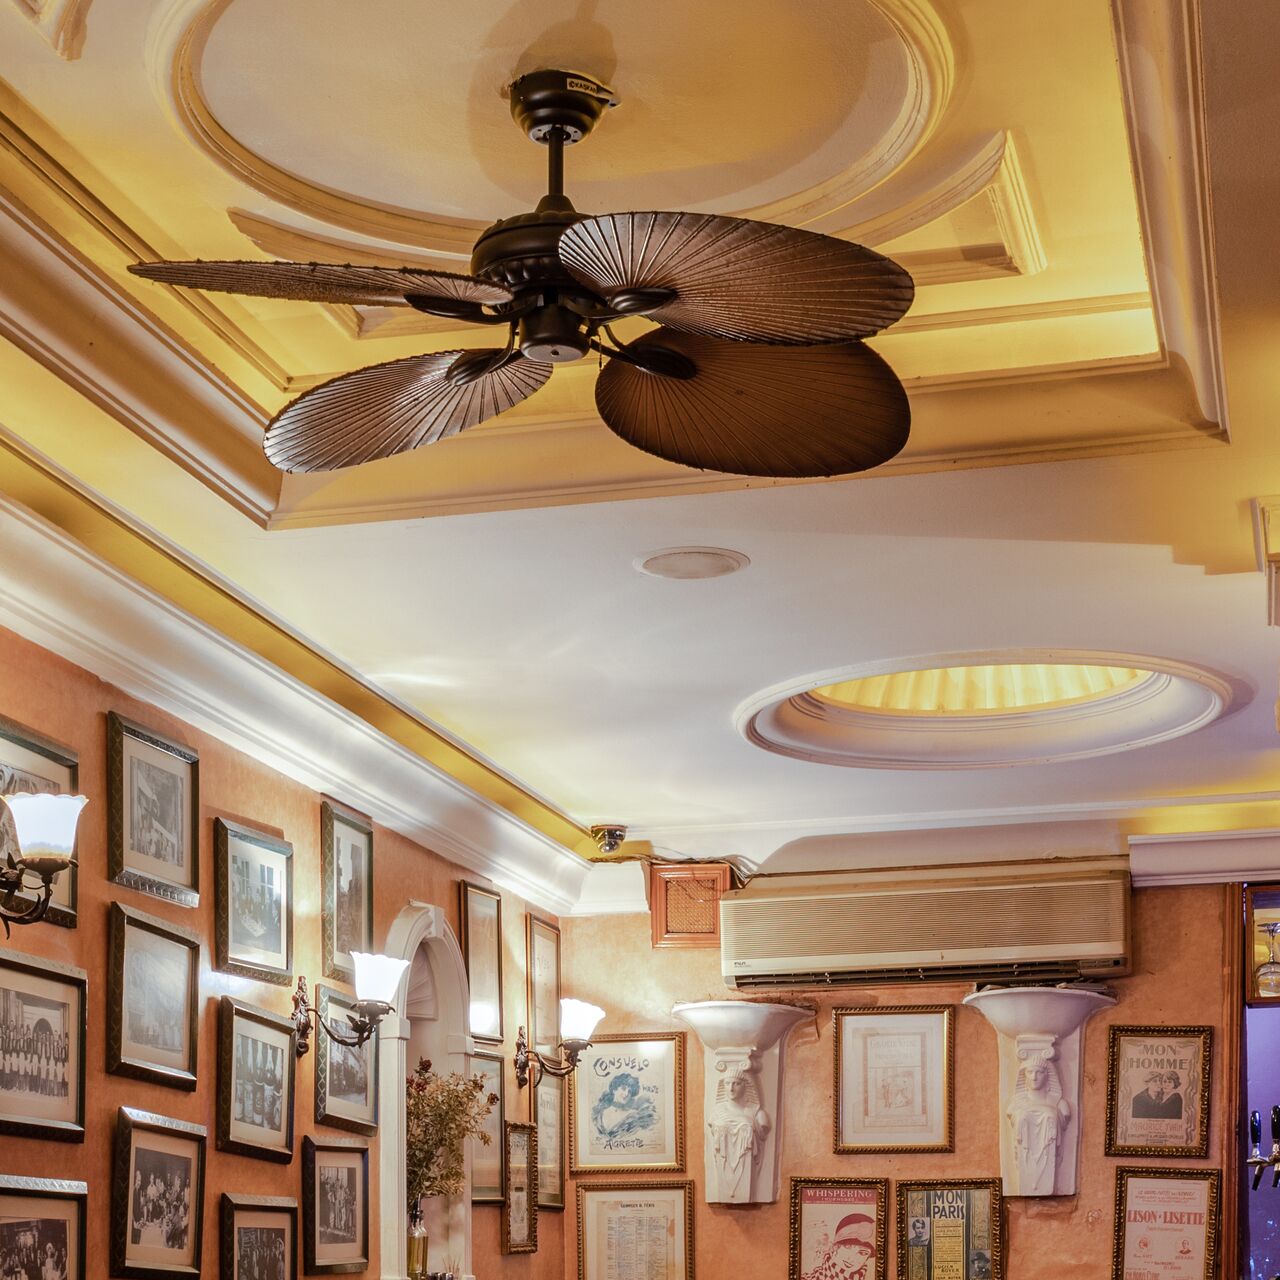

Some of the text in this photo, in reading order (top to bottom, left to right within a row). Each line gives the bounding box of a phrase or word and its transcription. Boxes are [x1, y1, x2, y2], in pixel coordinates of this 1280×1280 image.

[1142, 1044, 1178, 1056] MON
[593, 1056, 651, 1078] CONSUELO
[1129, 1058, 1190, 1070] HOMME
[806, 1189, 872, 1199] WHISPERING
[933, 1190, 965, 1205] MON
[932, 1205, 966, 1220] PARIS
[1127, 1210, 1205, 1226] LISON LISETTE
